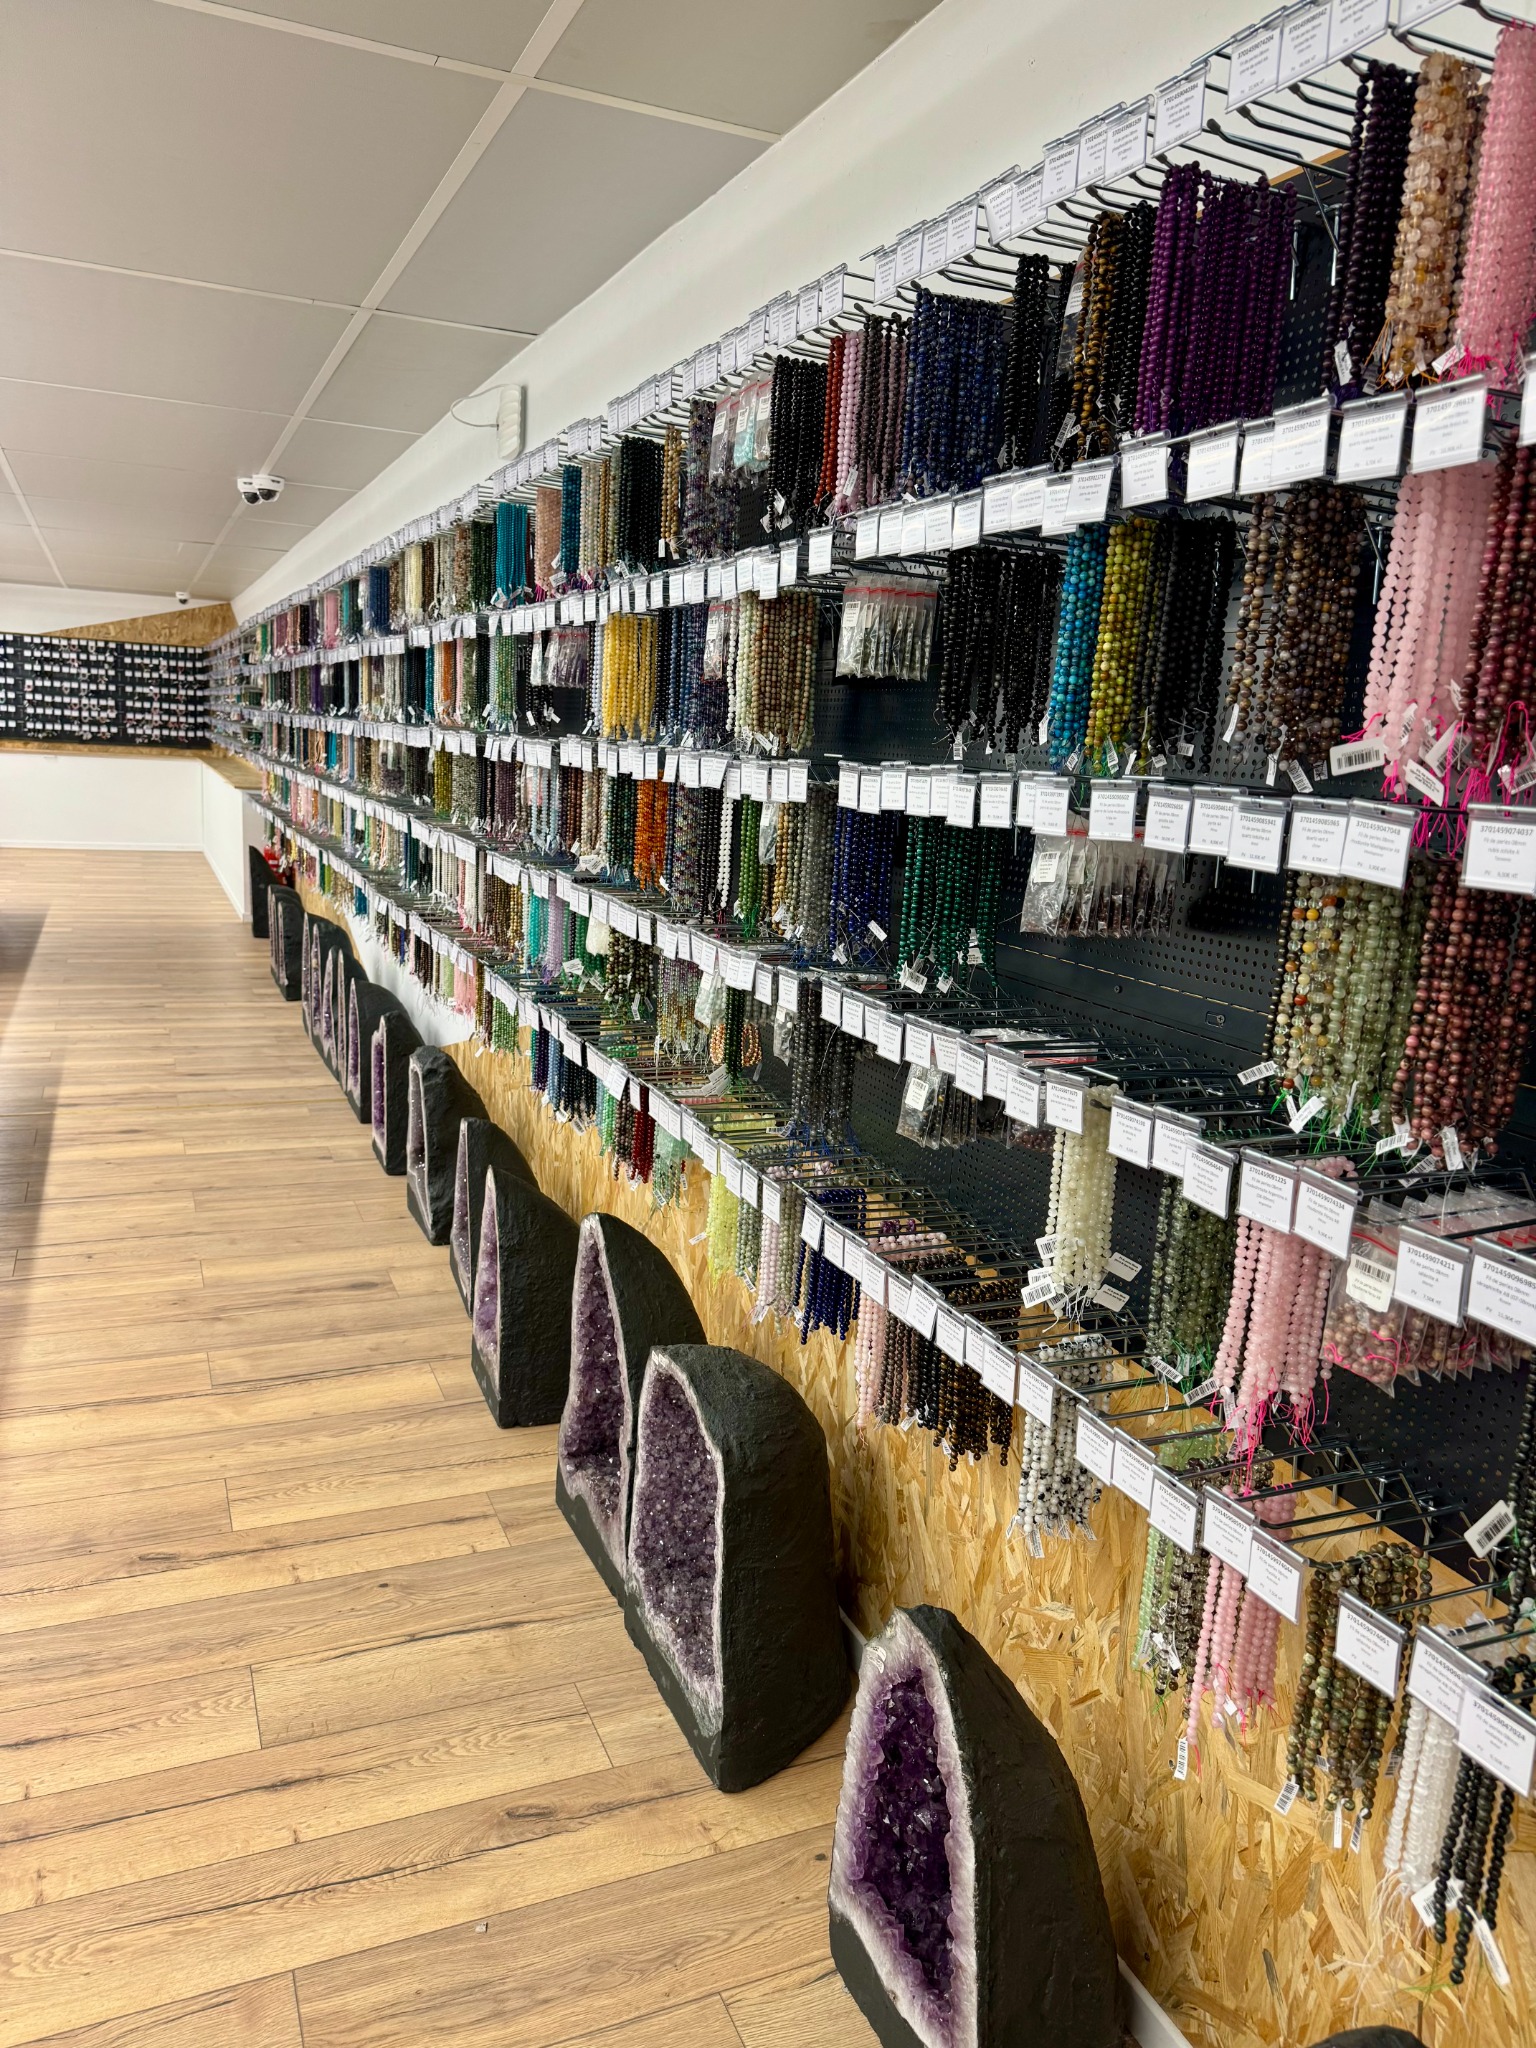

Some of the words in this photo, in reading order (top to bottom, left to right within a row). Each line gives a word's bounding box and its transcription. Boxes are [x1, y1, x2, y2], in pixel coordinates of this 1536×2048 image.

[1356, 820, 1401, 836] 3701459047048
[1480, 825, 1534, 836] 3701459074037
[1306, 1186, 1345, 1210] 3701459074334
[1407, 1246, 1455, 1271] 3701459074211
[1347, 1612, 1390, 1647] 3701459074051
[1473, 1700, 1526, 1742] 3701459047024
